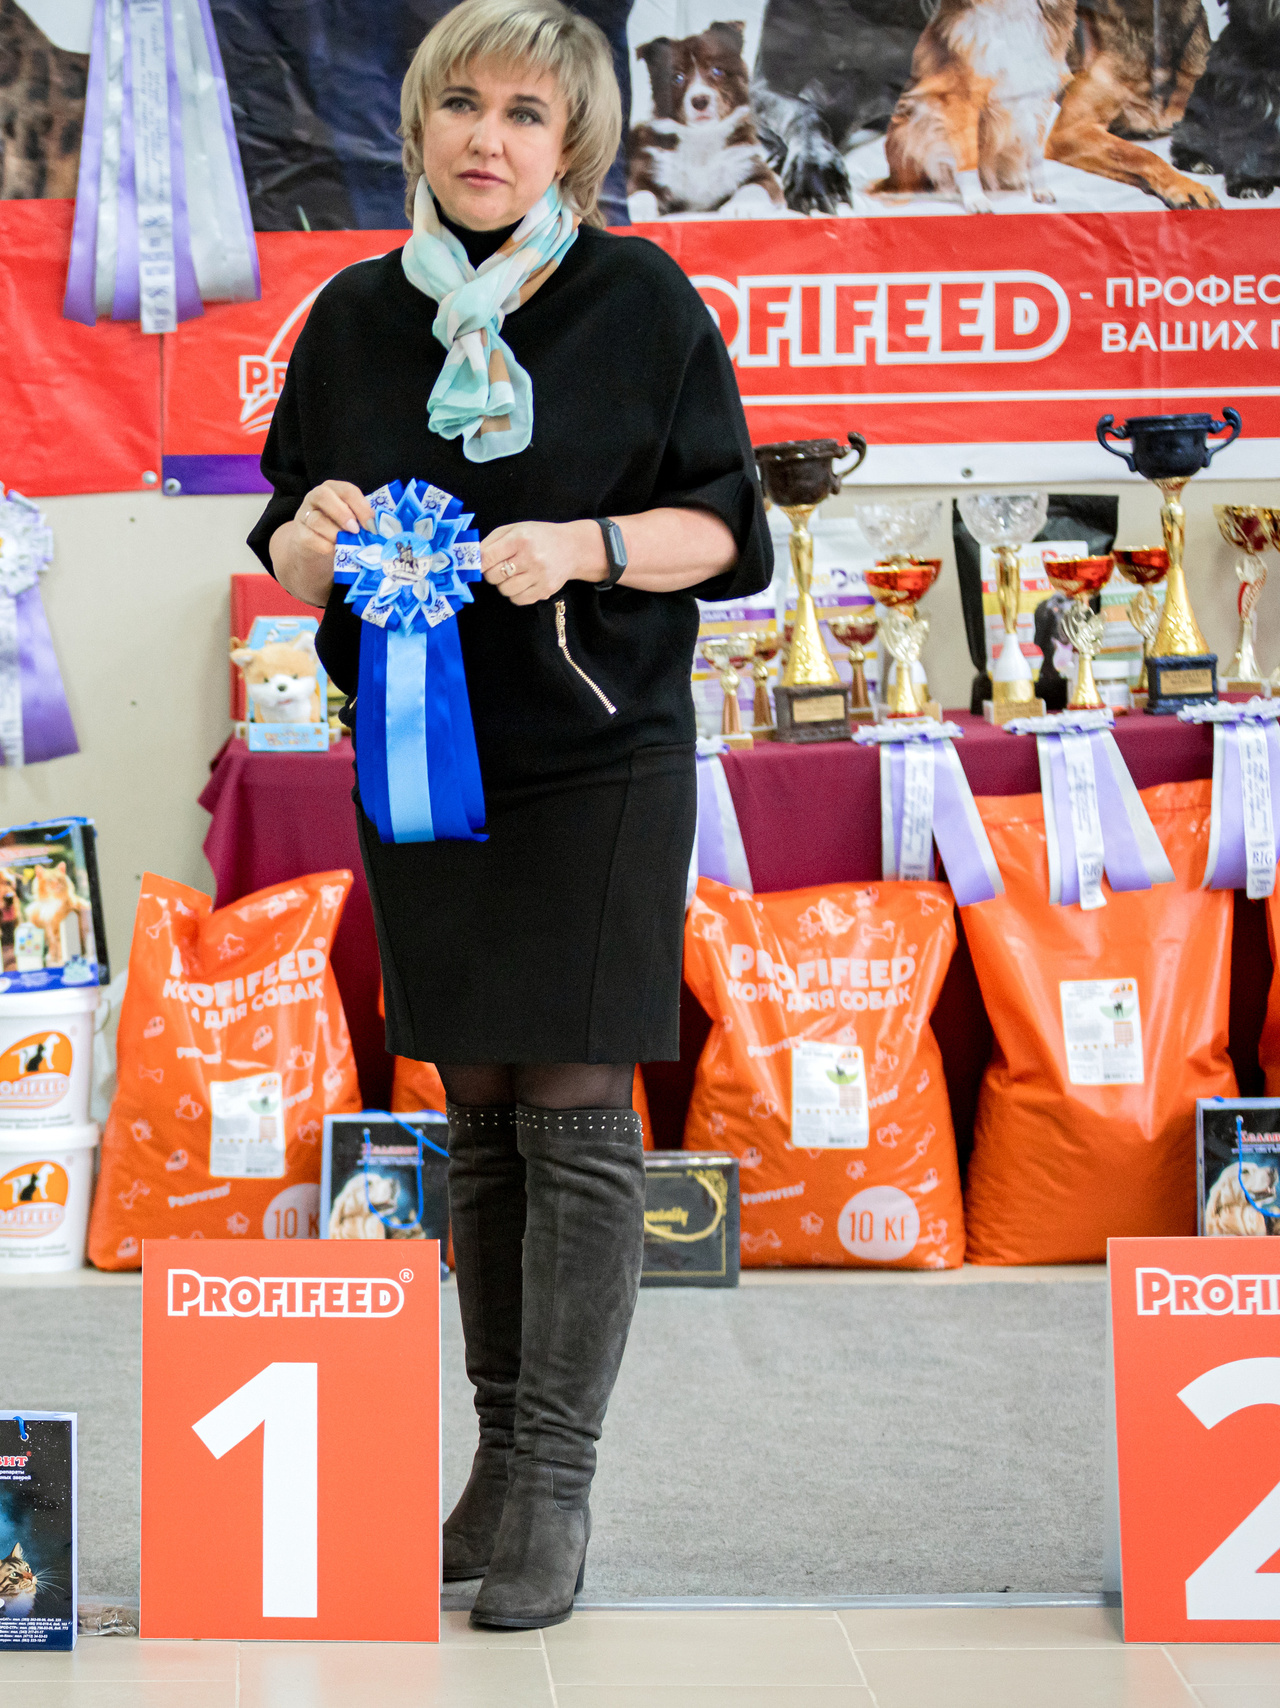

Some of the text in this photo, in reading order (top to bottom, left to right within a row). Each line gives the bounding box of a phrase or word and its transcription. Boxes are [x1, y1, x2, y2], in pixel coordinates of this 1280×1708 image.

[1101, 319, 1260, 353] ВАШИХ
[848, 1210, 874, 1243] 10
[191, 1361, 319, 1619] 1
[1176, 1356, 1280, 1621] 2
